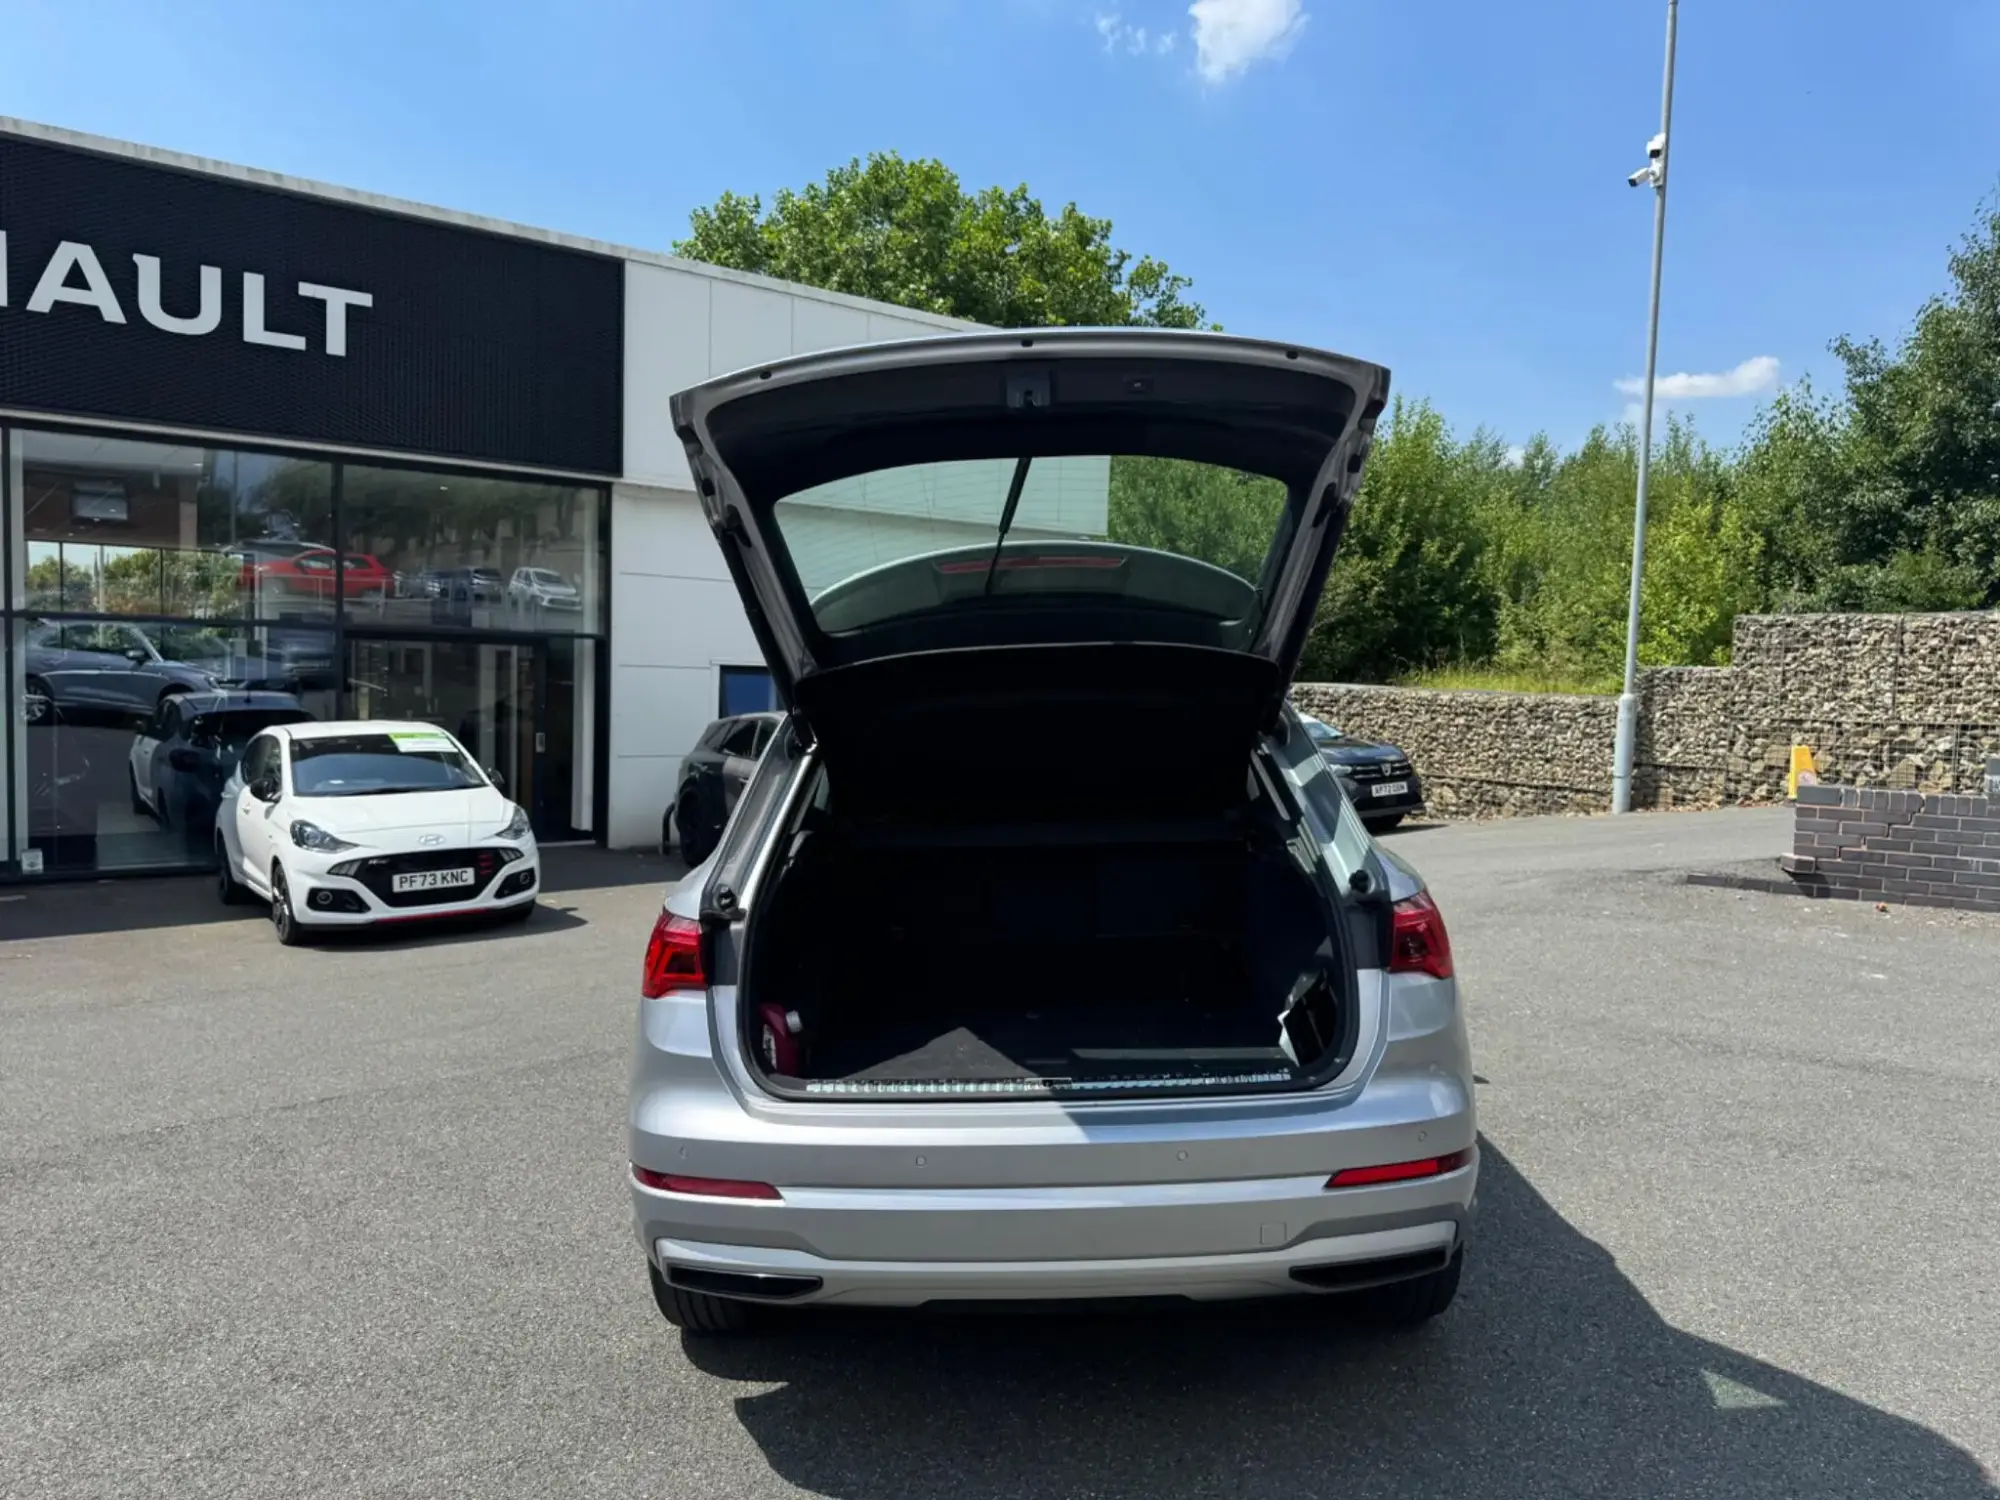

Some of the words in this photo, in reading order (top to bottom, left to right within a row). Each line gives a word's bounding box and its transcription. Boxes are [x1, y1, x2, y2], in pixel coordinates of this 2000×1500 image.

[0, 230, 373, 356] AULT
[399, 873, 437, 889] PF73
[440, 870, 469, 885] KNC
